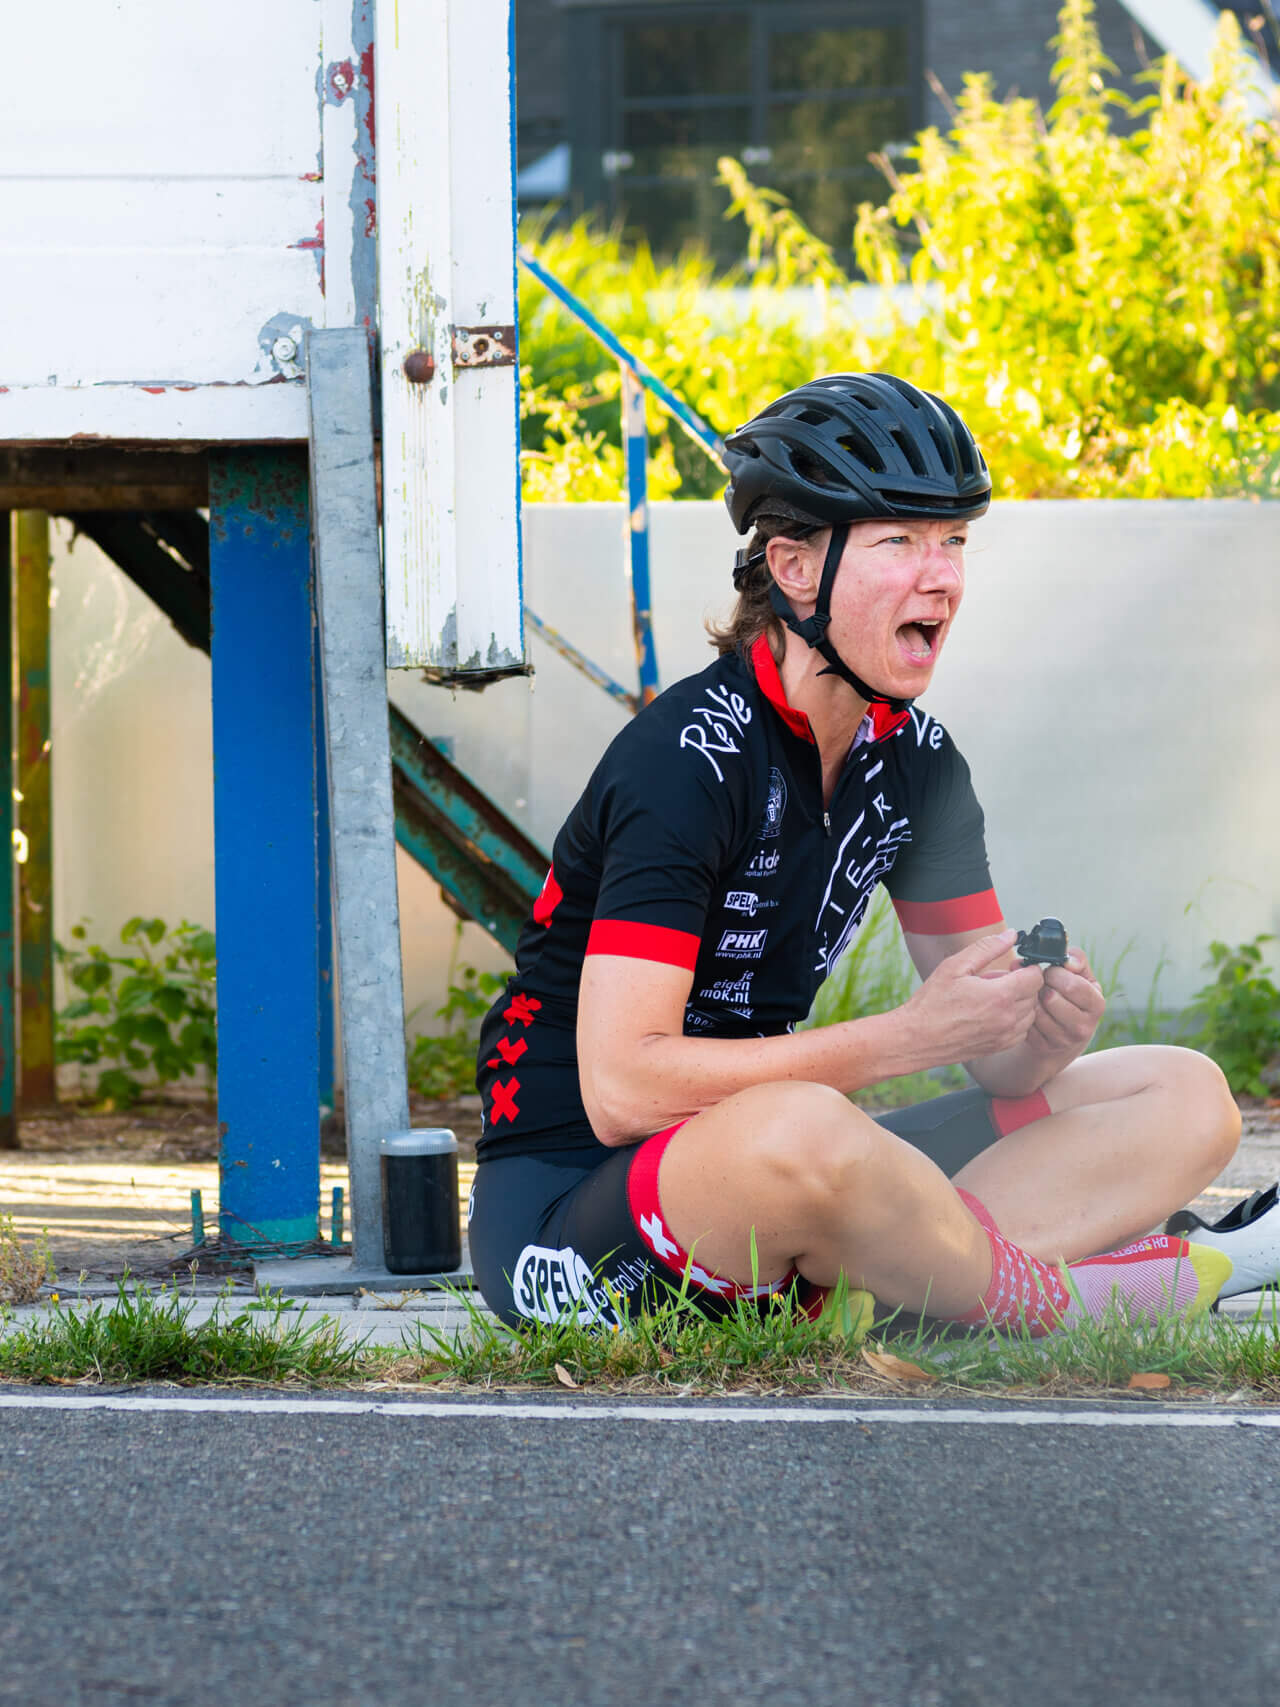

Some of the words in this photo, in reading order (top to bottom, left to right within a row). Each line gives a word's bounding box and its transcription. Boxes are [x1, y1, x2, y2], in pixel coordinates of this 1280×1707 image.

[749, 848, 780, 870] ride
[726, 893, 752, 908] SPEL
[720, 931, 766, 951] PHK
[715, 951, 762, 960] www.phk.nl
[740, 970, 754, 982] je
[713, 979, 751, 992] eigen
[699, 989, 750, 1004] mok.nl
[520, 1255, 588, 1313] SPEL
